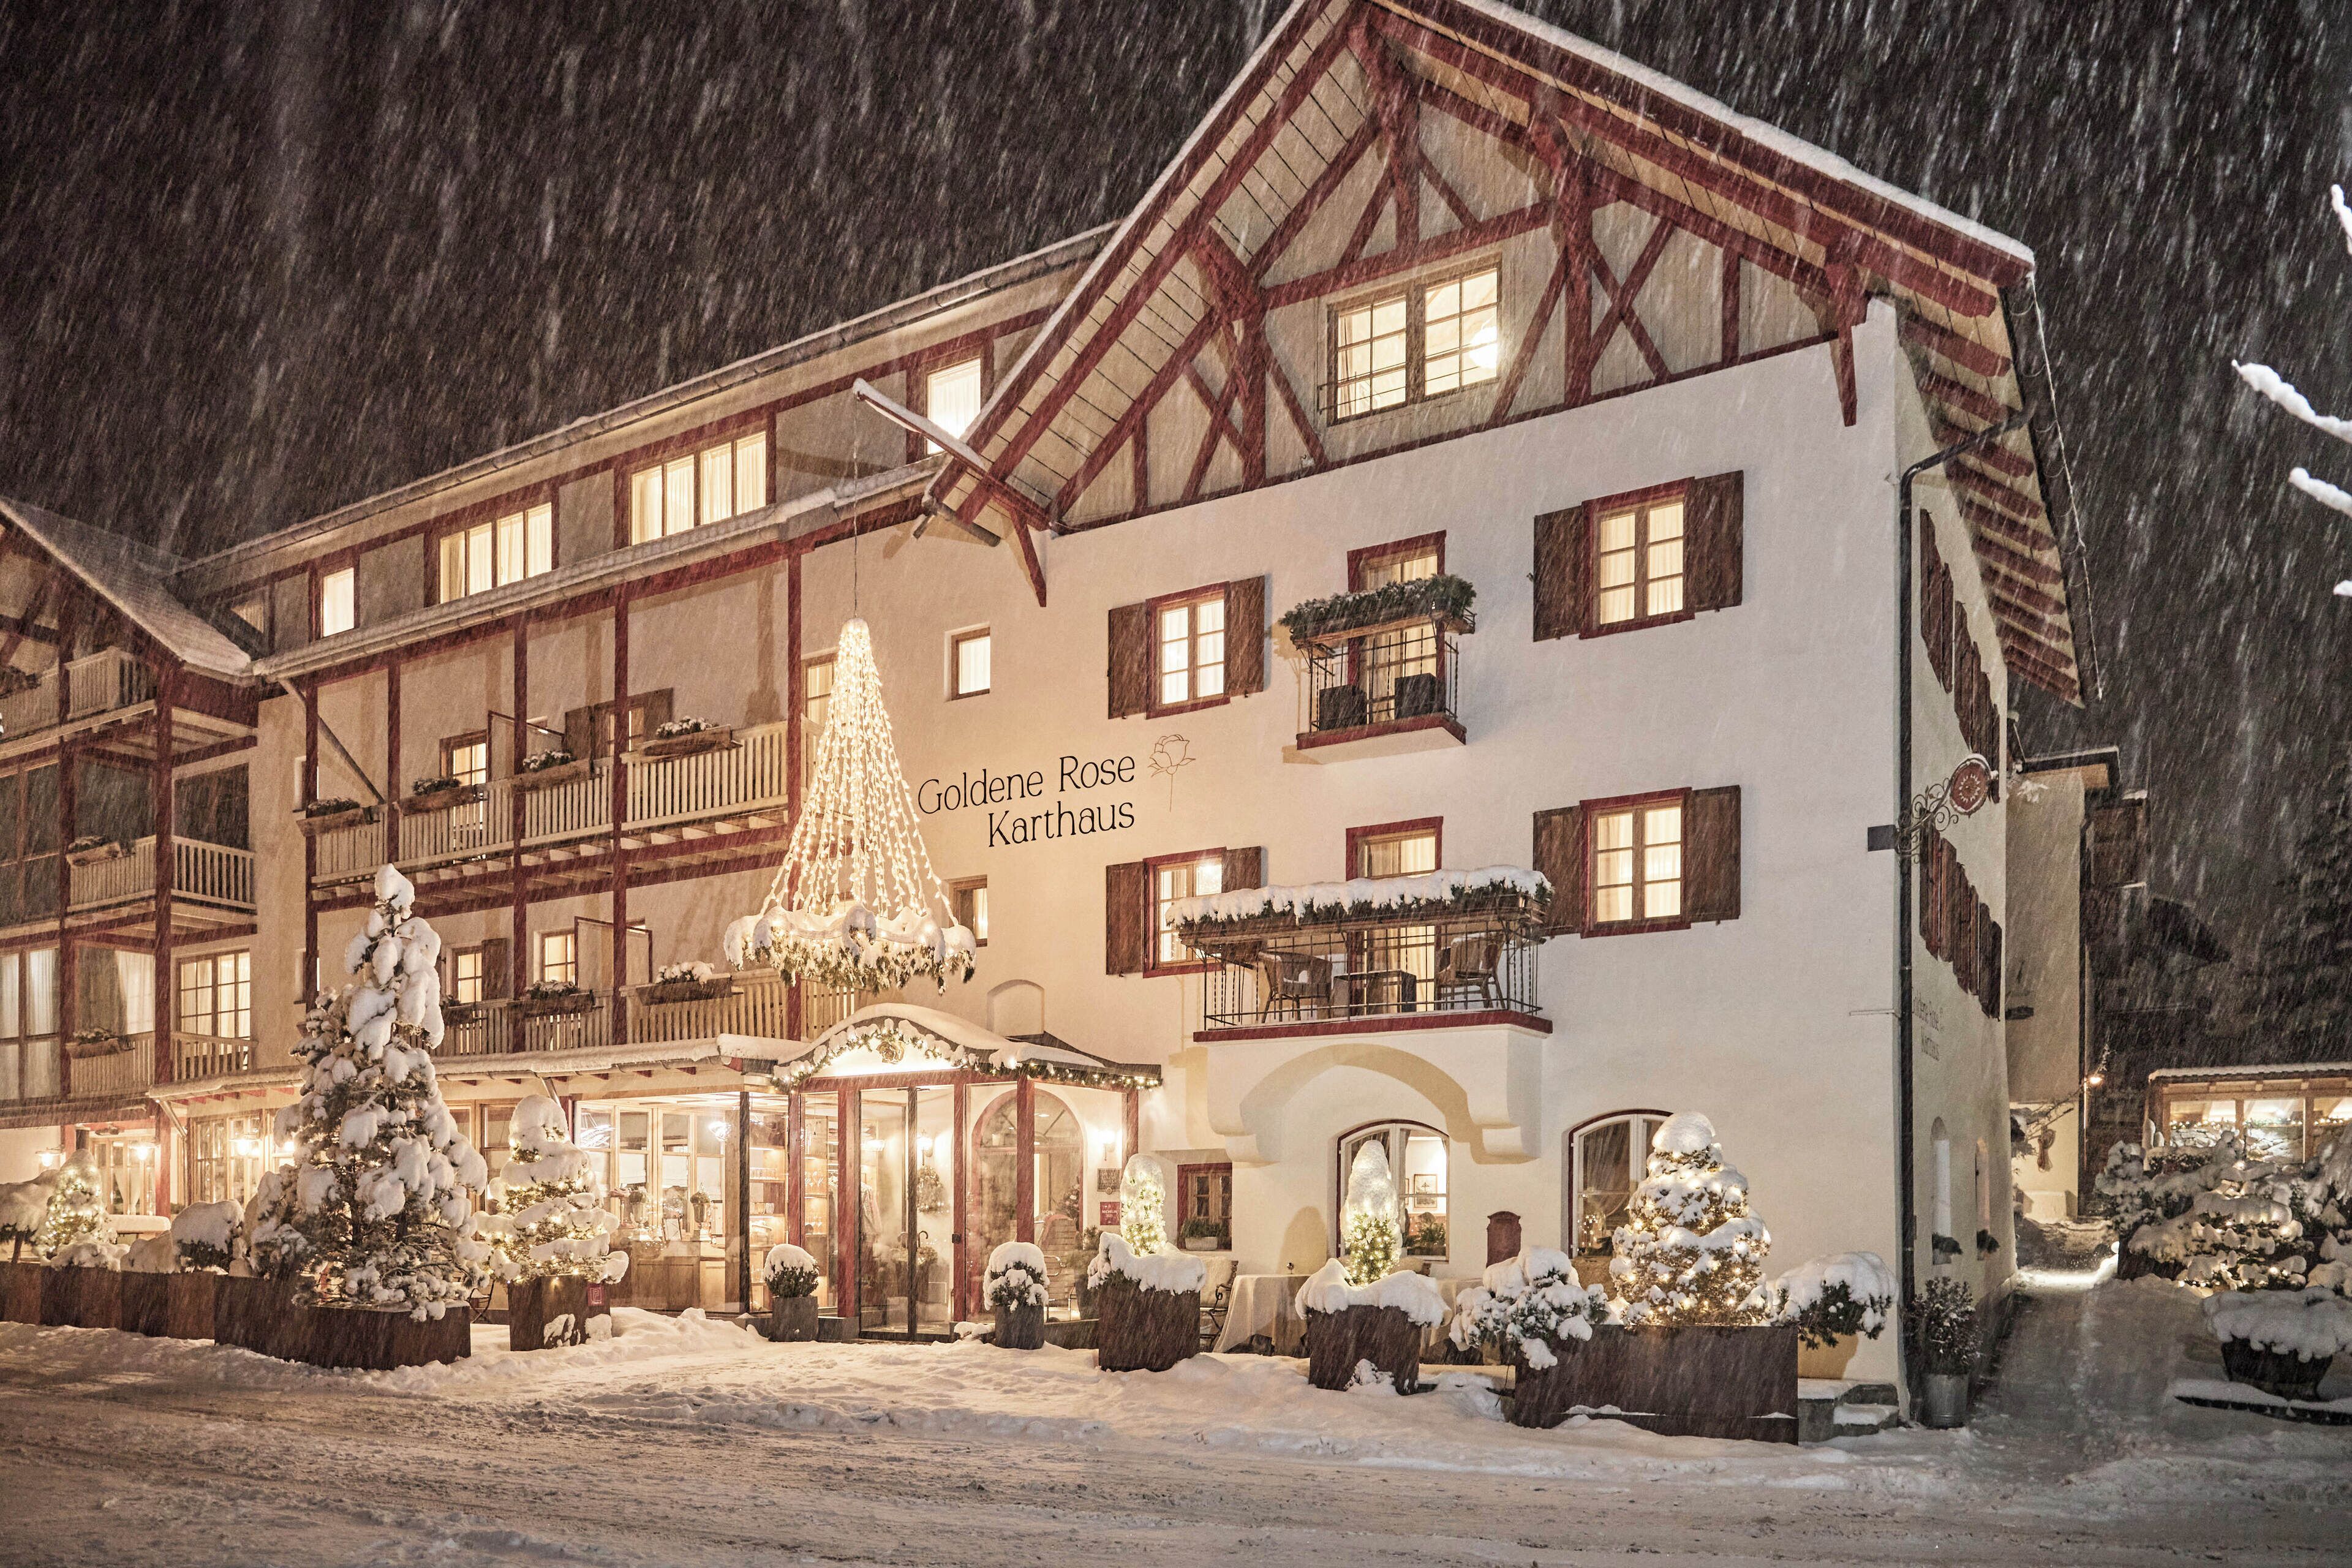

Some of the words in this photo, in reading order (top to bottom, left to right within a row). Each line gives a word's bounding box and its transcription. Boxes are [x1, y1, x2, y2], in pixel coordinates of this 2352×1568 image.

[918, 768, 1043, 815] Goldene
[1058, 755, 1135, 793] Rose
[988, 801, 1135, 848] Karthaus
